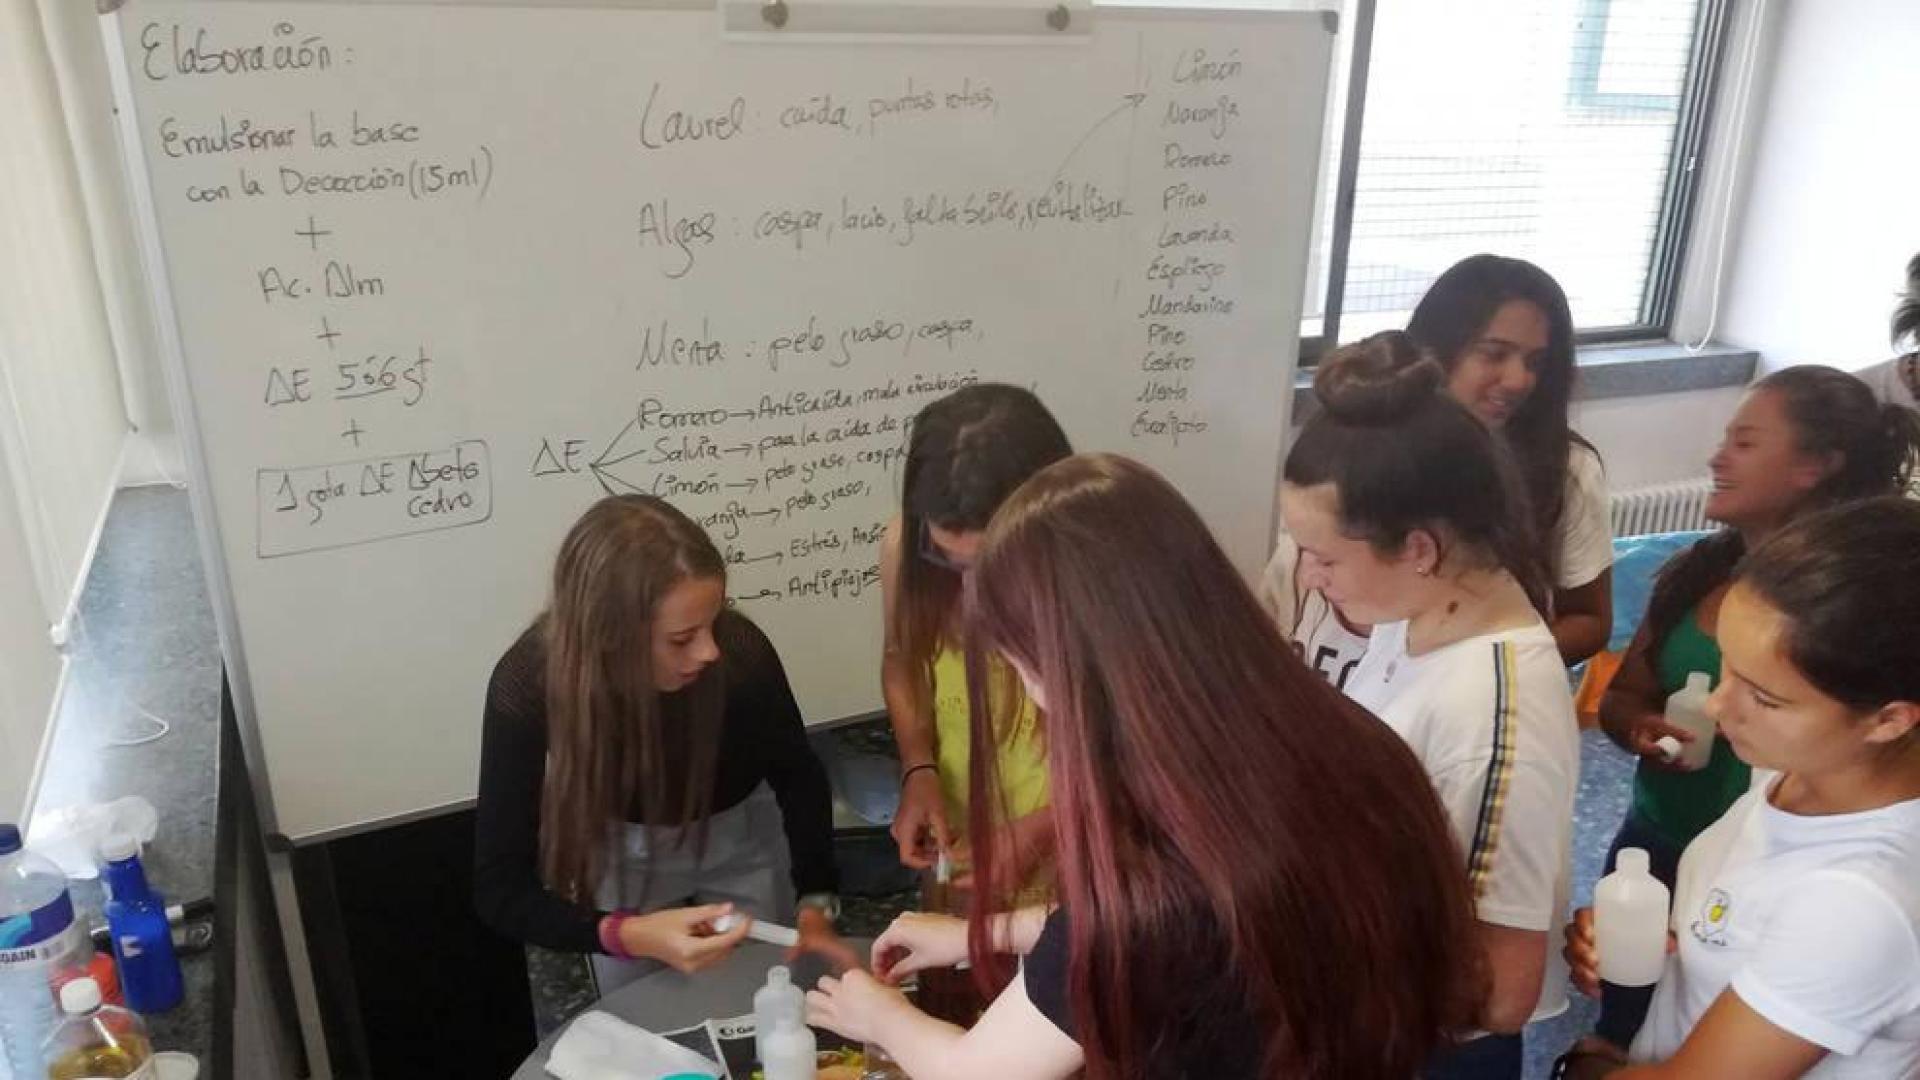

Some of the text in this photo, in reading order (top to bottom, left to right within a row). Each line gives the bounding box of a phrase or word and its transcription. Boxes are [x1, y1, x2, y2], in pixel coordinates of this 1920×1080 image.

[310, 110, 338, 149] la
[352, 110, 420, 146] base
[1161, 95, 1240, 140] Naranja
[186, 184, 230, 202] con
[240, 167, 265, 196] la
[1163, 183, 1208, 211] Pino
[768, 316, 824, 371] pelo
[1148, 323, 1187, 344] Pino
[638, 397, 729, 430] Romero
[648, 435, 721, 463] Salvia
[876, 415, 896, 433] de
[765, 458, 795, 492] pelo
[406, 487, 473, 519] Cedro
[697, 501, 749, 540] ranja
[786, 488, 816, 518] pelo
